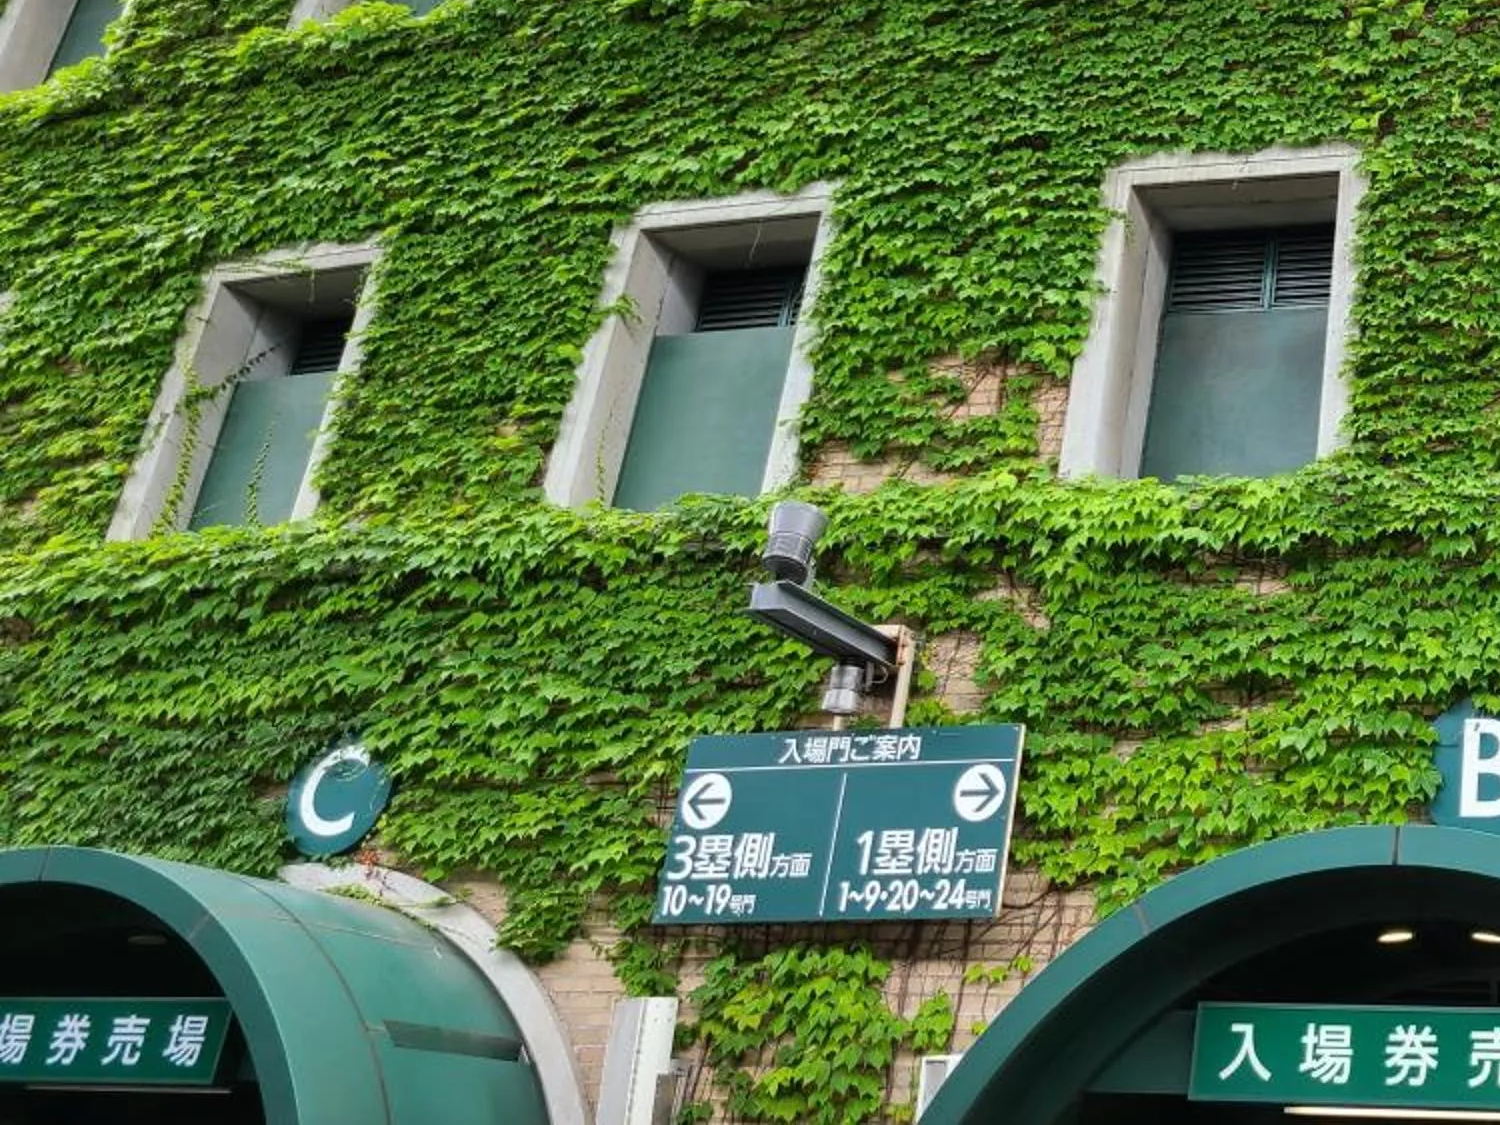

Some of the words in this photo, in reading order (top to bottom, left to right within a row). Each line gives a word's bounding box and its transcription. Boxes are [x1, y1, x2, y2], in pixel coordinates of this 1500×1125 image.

[777, 734, 922, 764] 入場門ご案内
[300, 743, 371, 837] C
[667, 831, 813, 881] 3塁側方面
[856, 826, 998, 876] 1塁側方面
[0, 1013, 209, 1067] 場券売場
